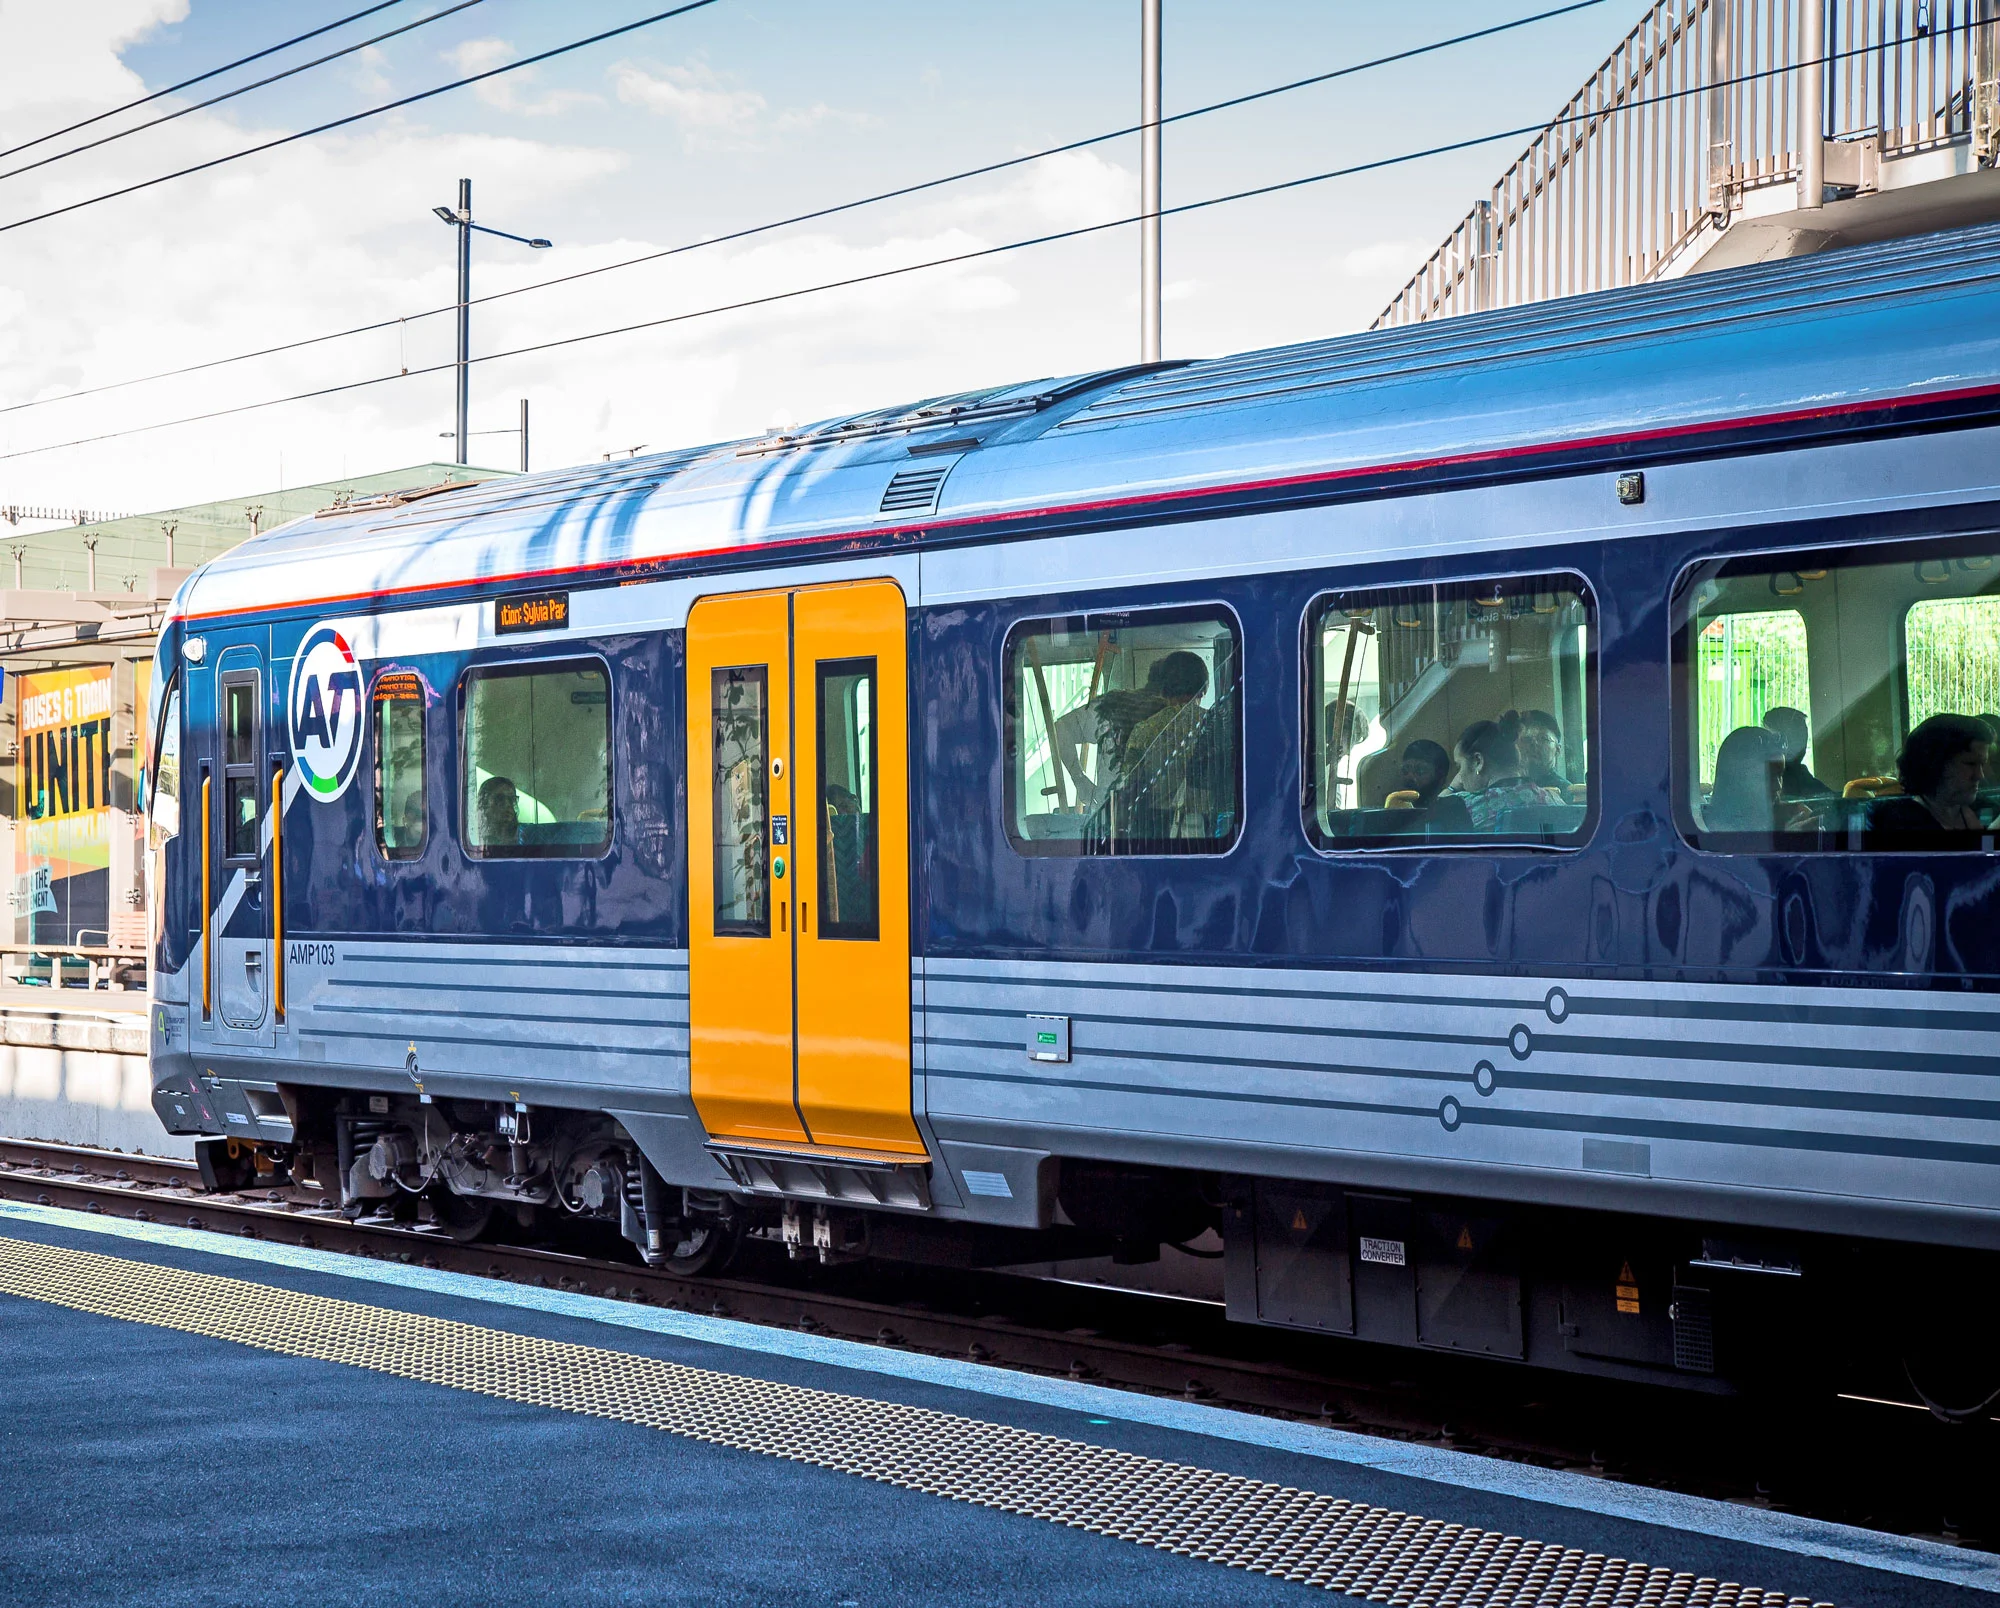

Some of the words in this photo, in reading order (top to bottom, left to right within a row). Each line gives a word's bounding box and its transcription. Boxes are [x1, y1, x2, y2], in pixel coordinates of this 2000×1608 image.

[523, 602, 549, 625] Sylvia
[22, 690, 63, 731] BUSES
[64, 687, 73, 721] &
[294, 670, 358, 750] AT
[35, 868, 48, 890] THE
[289, 943, 335, 966] AMP103
[1361, 1249, 1404, 1264] CONVERTER
[1364, 1240, 1401, 1253] TRACTION
